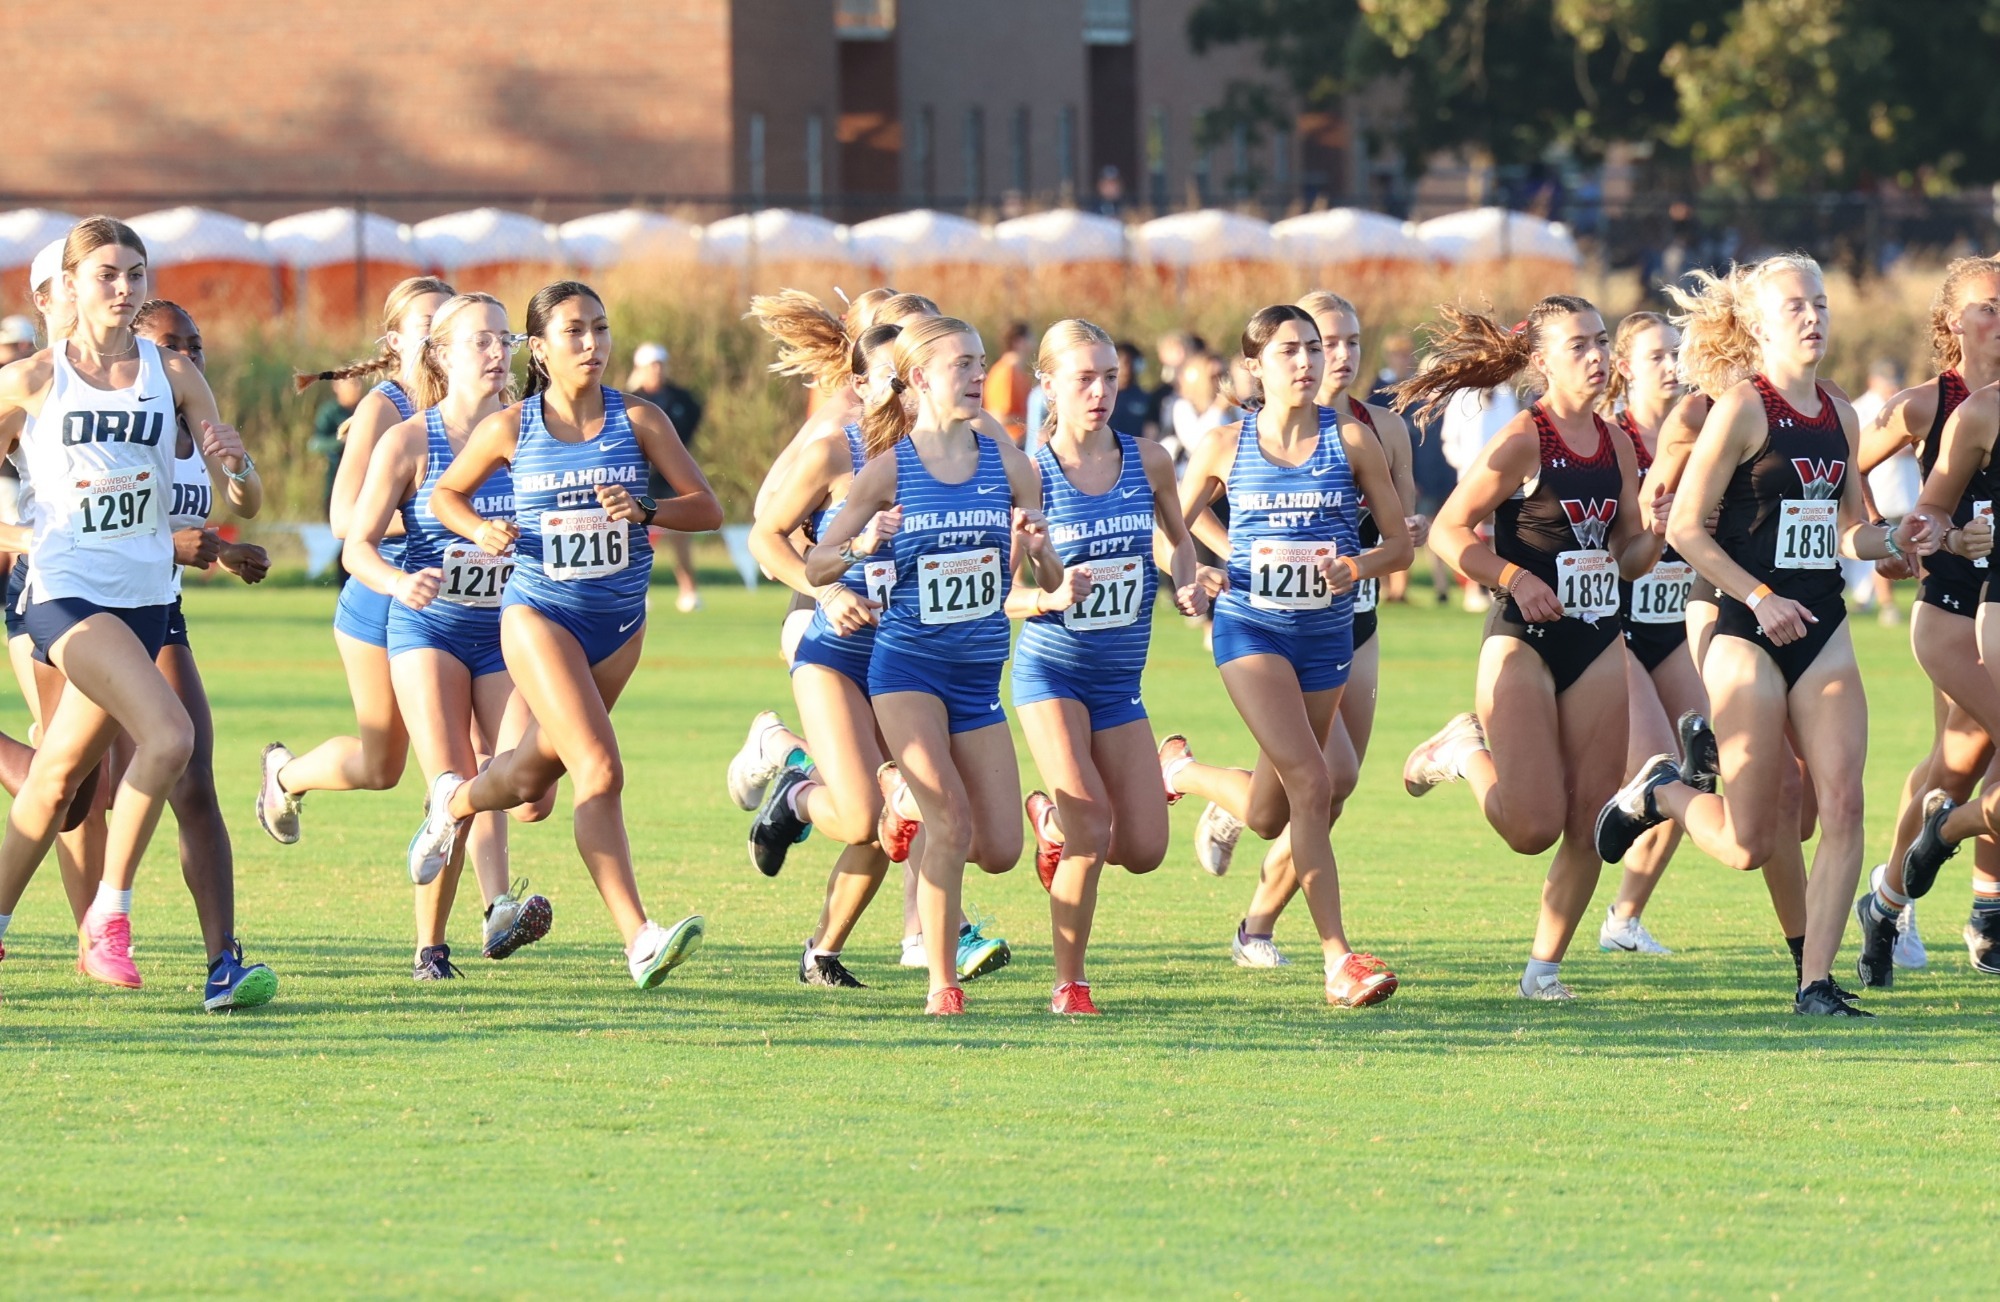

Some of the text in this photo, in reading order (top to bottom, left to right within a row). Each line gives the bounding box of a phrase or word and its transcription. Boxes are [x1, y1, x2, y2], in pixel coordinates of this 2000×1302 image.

[62, 410, 164, 447] ORU
[92, 482, 137, 494] JAMBOREE
[95, 475, 132, 487] COWBOY
[521, 466, 637, 492] OKLAHOMA
[1791, 457, 1845, 500] W
[1238, 491, 1342, 510] OKLAHOMA
[80, 489, 152, 534] 1297
[566, 516, 604, 525] COWBOY
[1268, 511, 1314, 527] CITY
[1799, 514, 1829, 522] JAMBOREE
[1802, 507, 1827, 515] COWBOY
[563, 523, 608, 533] JAMBOREE
[904, 510, 1009, 533] OKLAHOMA
[1053, 513, 1153, 544] OKLAHOMA
[1560, 497, 1618, 550] W
[938, 531, 986, 548] CITY
[1089, 535, 1134, 557] CITY
[1784, 524, 1835, 559] 1830
[551, 531, 622, 569] 1216
[1273, 555, 1316, 563] JAMBOREE
[1276, 548, 1313, 556] COWBOY
[464, 558, 505, 566] JAMBOREE
[940, 565, 983, 576] JAMBOREE
[942, 558, 979, 569] COWBOY
[1259, 563, 1327, 598] 1215
[927, 571, 995, 613] 1218
[1564, 572, 1617, 609] 1832
